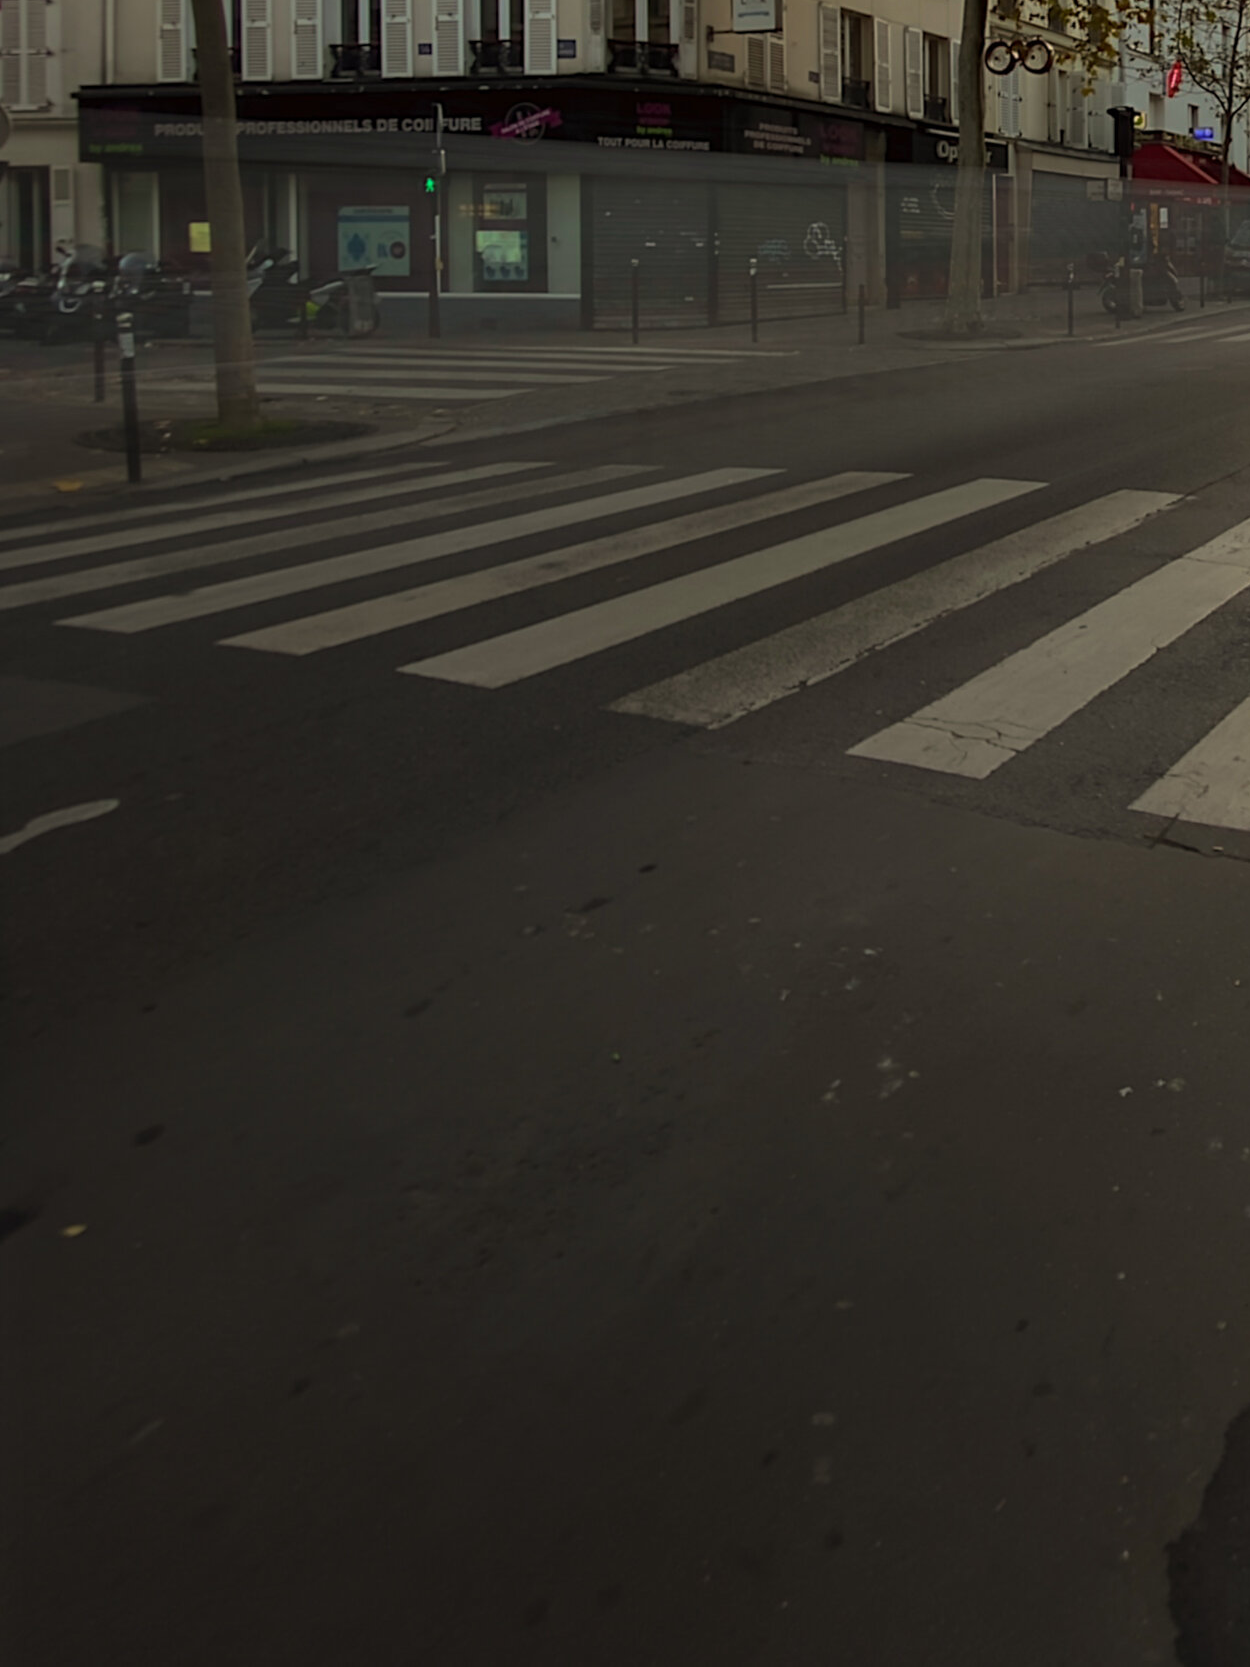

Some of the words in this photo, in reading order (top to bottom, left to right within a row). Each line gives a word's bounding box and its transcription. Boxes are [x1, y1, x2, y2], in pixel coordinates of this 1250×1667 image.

[154, 123, 204, 136] PRODU
[236, 119, 373, 136] PROFESSIONNELS
[376, 118, 399, 132] DE
[597, 136, 623, 147] TOUT
[624, 137, 650, 148] POUR
[652, 138, 664, 149] LA
[666, 139, 710, 151] COIFFURE
